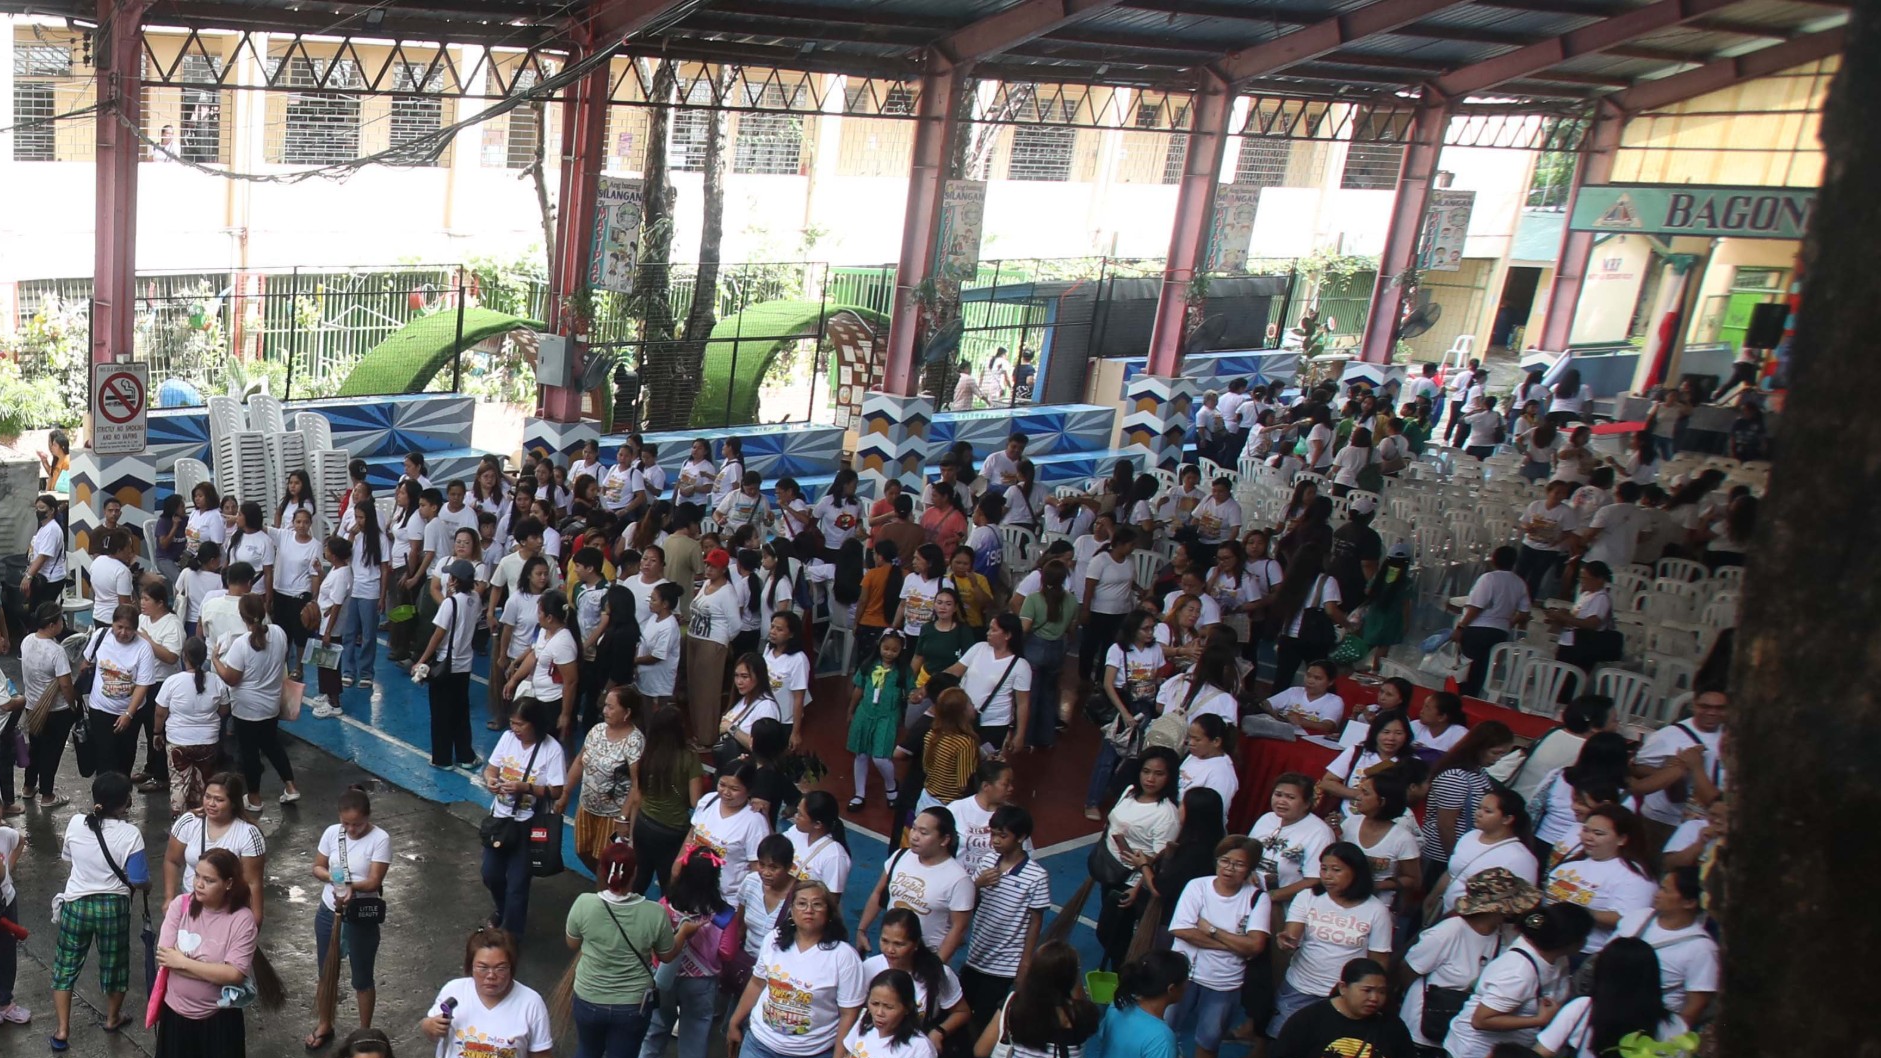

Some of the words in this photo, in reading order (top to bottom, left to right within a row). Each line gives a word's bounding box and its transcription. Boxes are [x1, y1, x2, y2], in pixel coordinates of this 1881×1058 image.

[598, 188, 643, 202] SILANGAN
[890, 884, 929, 909] Woman
[358, 910, 379, 918] BEAUTY
[359, 905, 379, 913] LITTLE
[1306, 908, 1371, 934] Adele
